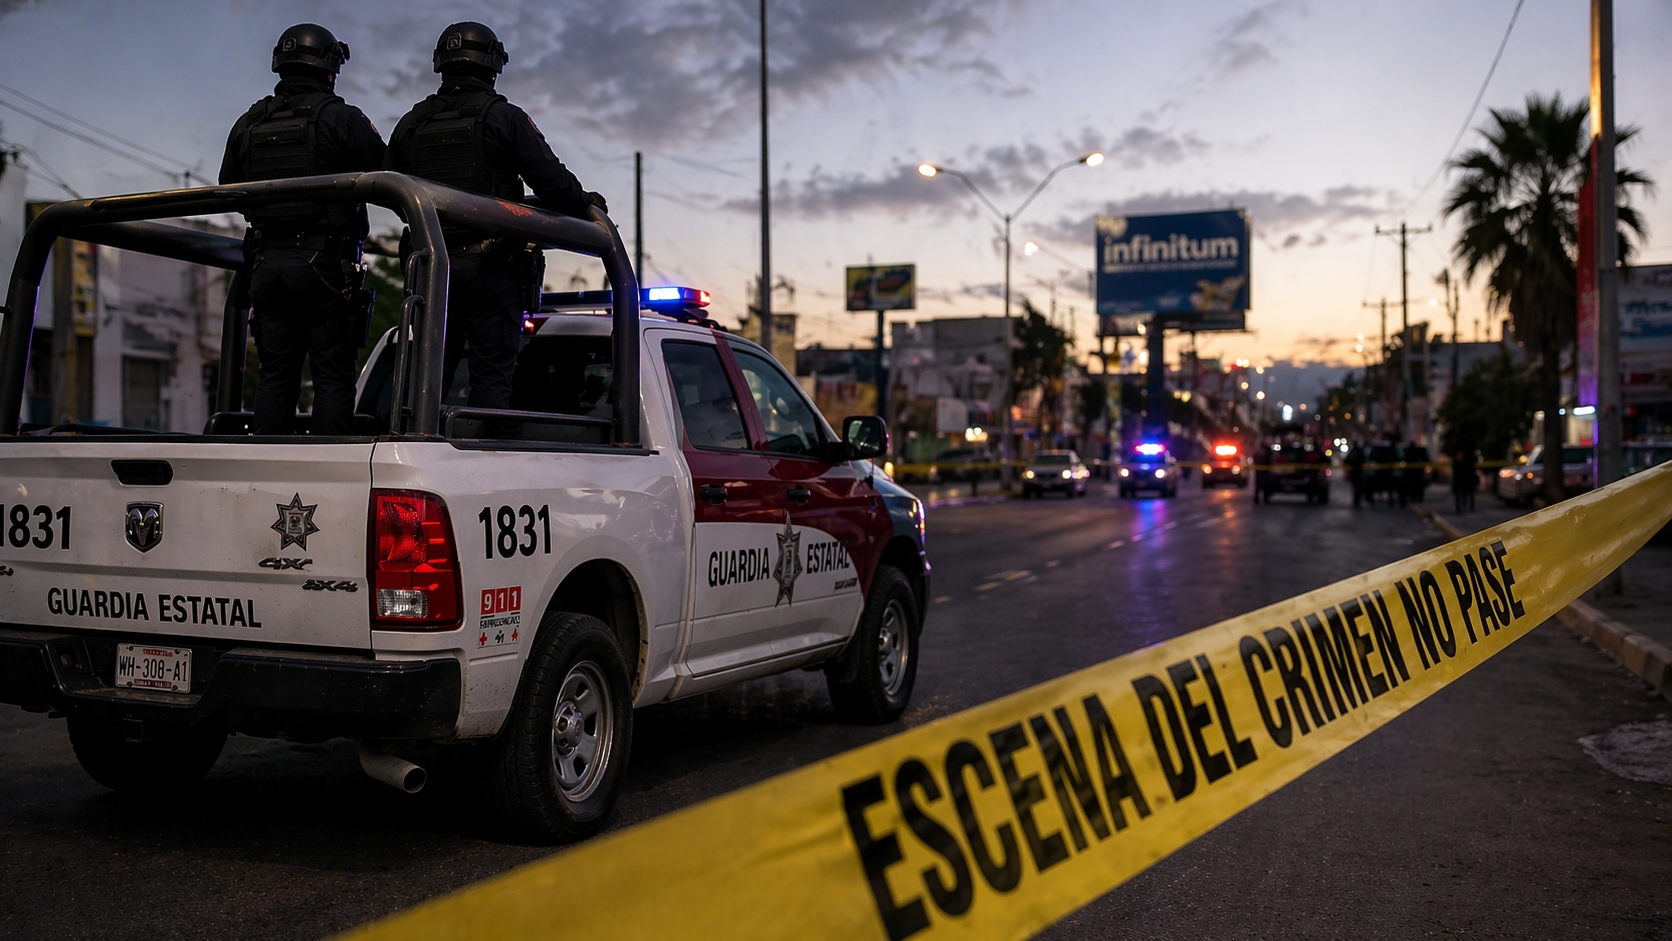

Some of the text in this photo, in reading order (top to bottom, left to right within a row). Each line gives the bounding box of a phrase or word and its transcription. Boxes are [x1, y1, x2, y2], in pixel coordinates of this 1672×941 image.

[1103, 232, 1239, 264] infinitum
[478, 504, 552, 559] 1831
[708, 541, 850, 588] GUARDIA ESTATAL
[47, 586, 262, 629] GUARDIA ESTATAL
[483, 589, 519, 613] 911
[119, 655, 188, 682] WH-308-A1
[841, 540, 1527, 941] ESCENA DEL CRIMEN NO PASE
